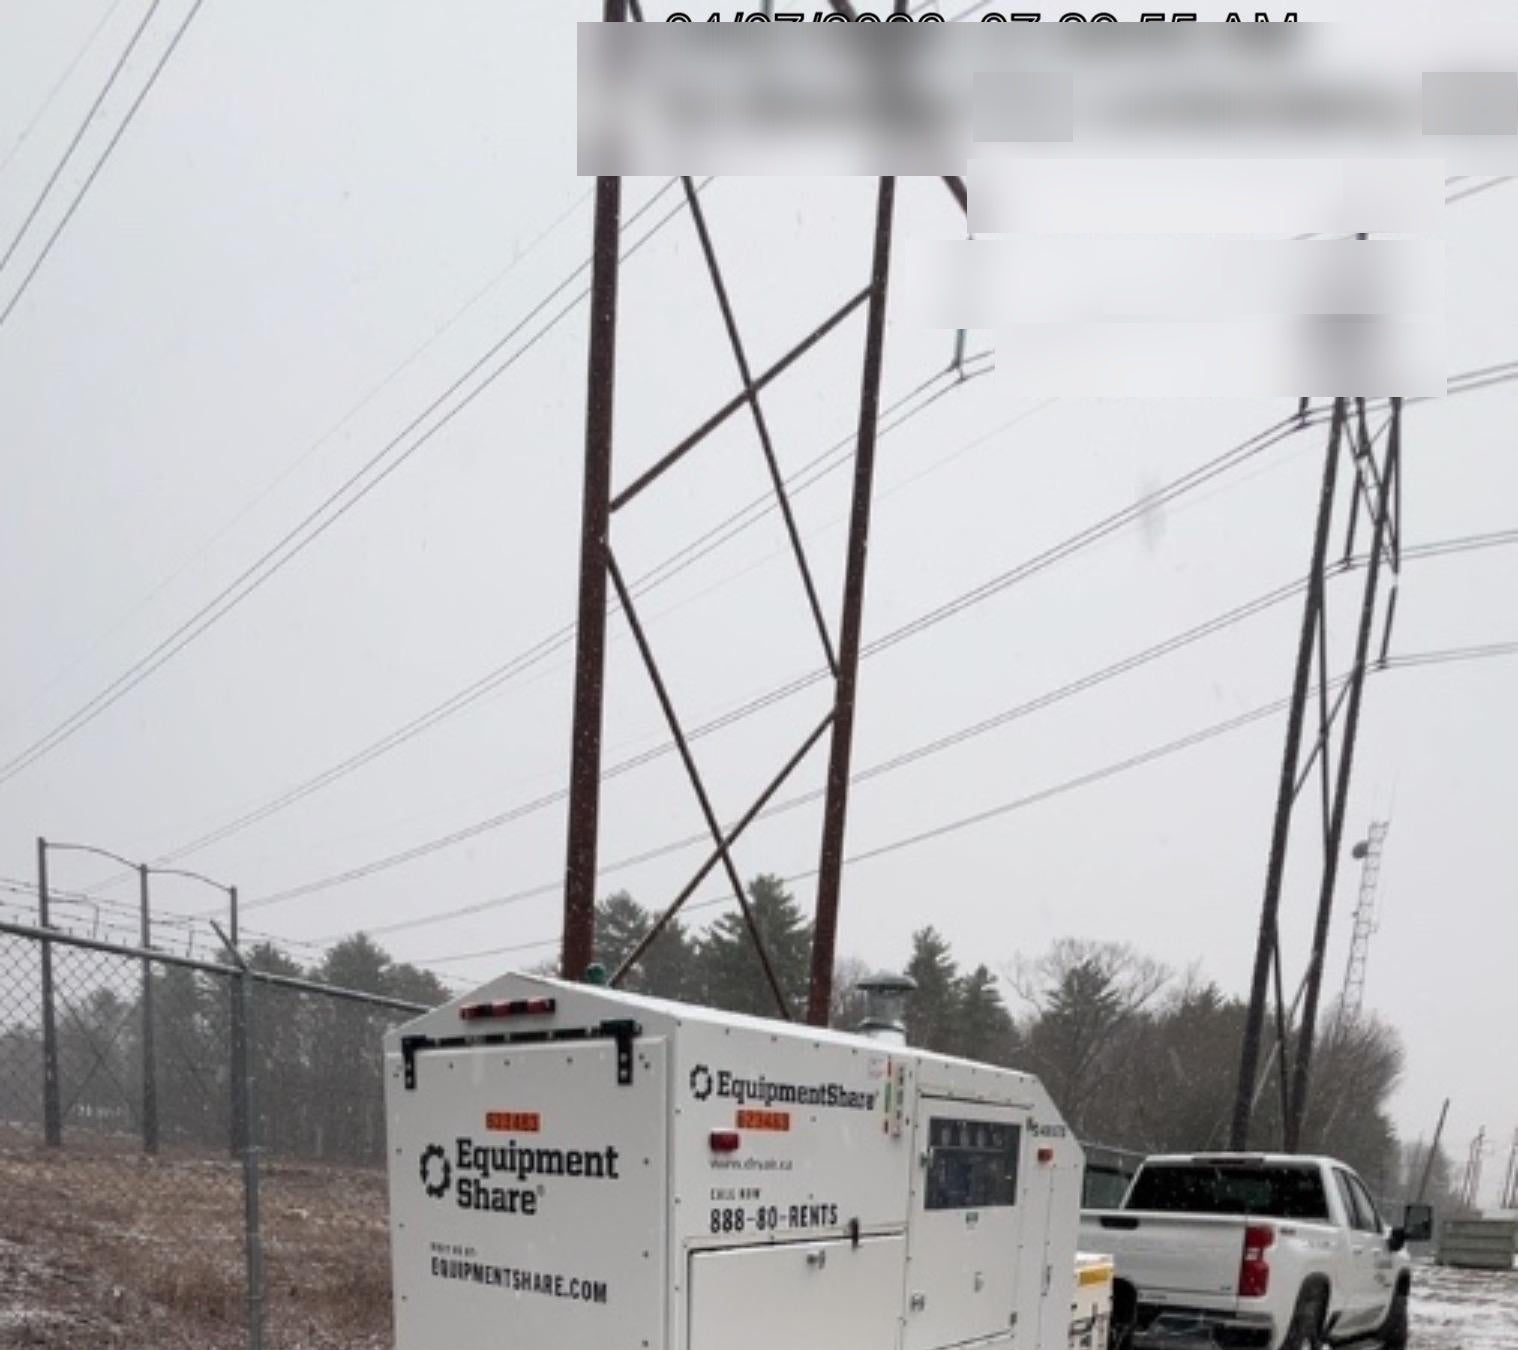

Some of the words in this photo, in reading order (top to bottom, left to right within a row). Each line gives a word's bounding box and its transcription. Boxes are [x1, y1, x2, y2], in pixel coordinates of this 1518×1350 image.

[716, 1070, 876, 1111] EquipmentShare
[455, 1138, 619, 1181] Equipment
[709, 1203, 839, 1235] 888-80-RENTS
[430, 1255, 608, 1304] EQUIPMENTSHARE.COM
